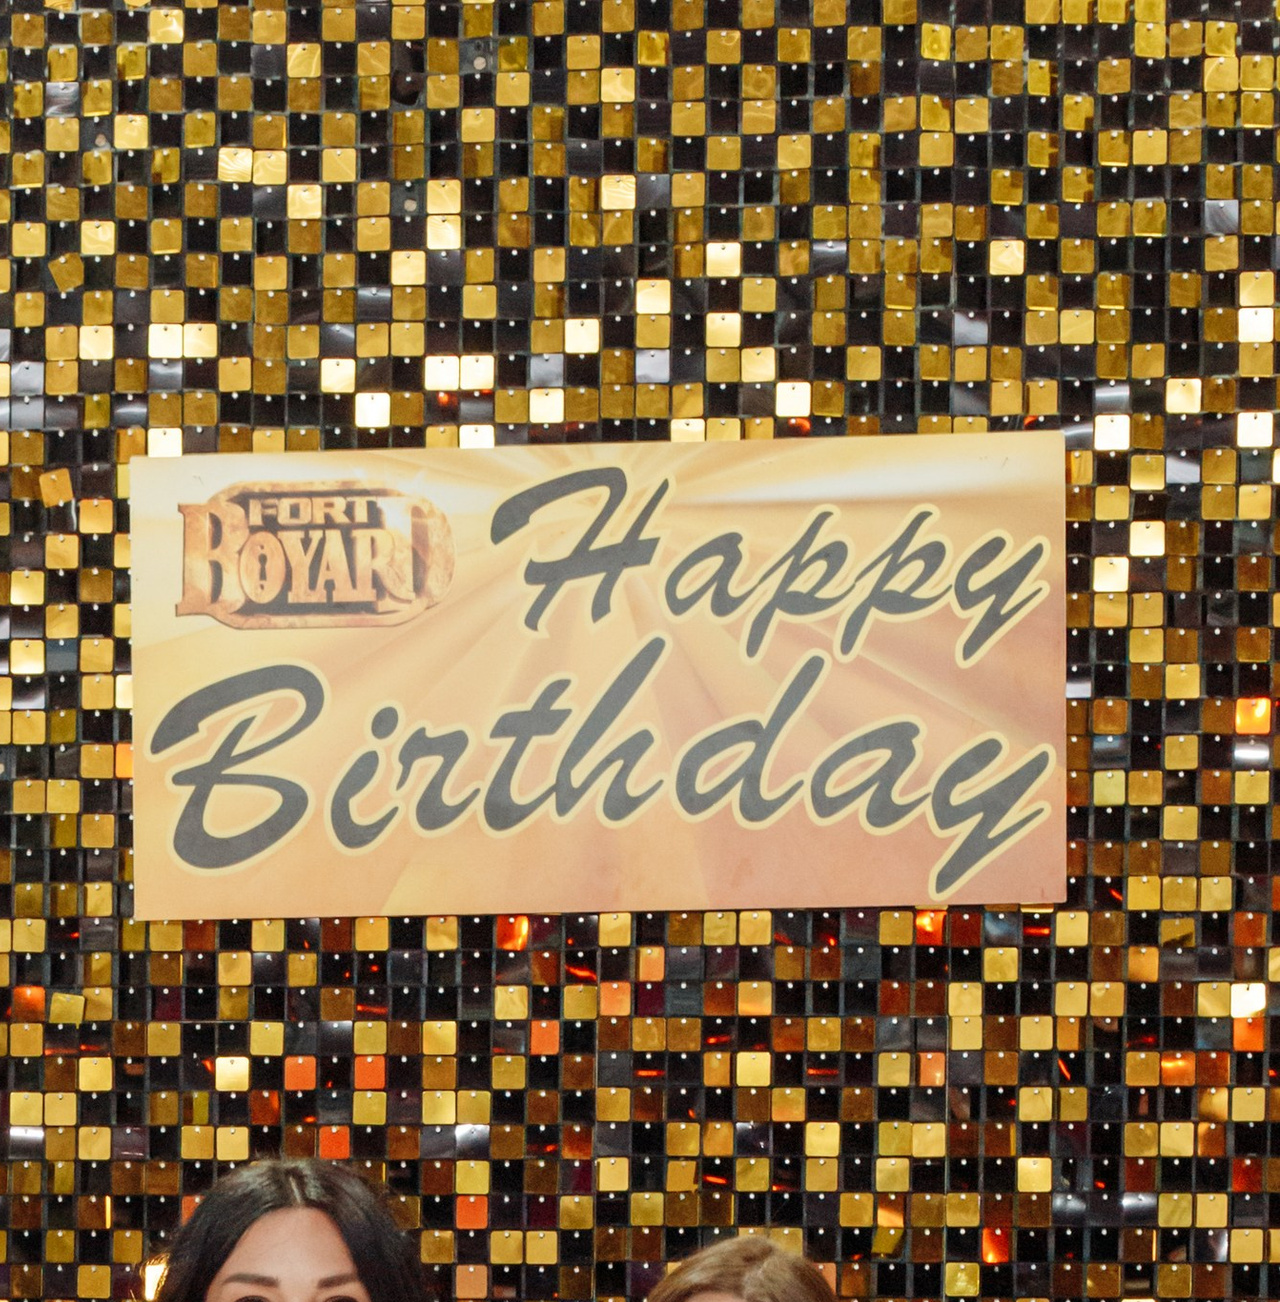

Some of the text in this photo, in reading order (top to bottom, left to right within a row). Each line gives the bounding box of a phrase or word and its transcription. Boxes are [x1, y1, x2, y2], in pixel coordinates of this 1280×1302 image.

[175, 495, 456, 617] BOYARD
[248, 496, 377, 526] FORT
[490, 466, 1047, 662] Happy
[148, 636, 1052, 897] Birthday
